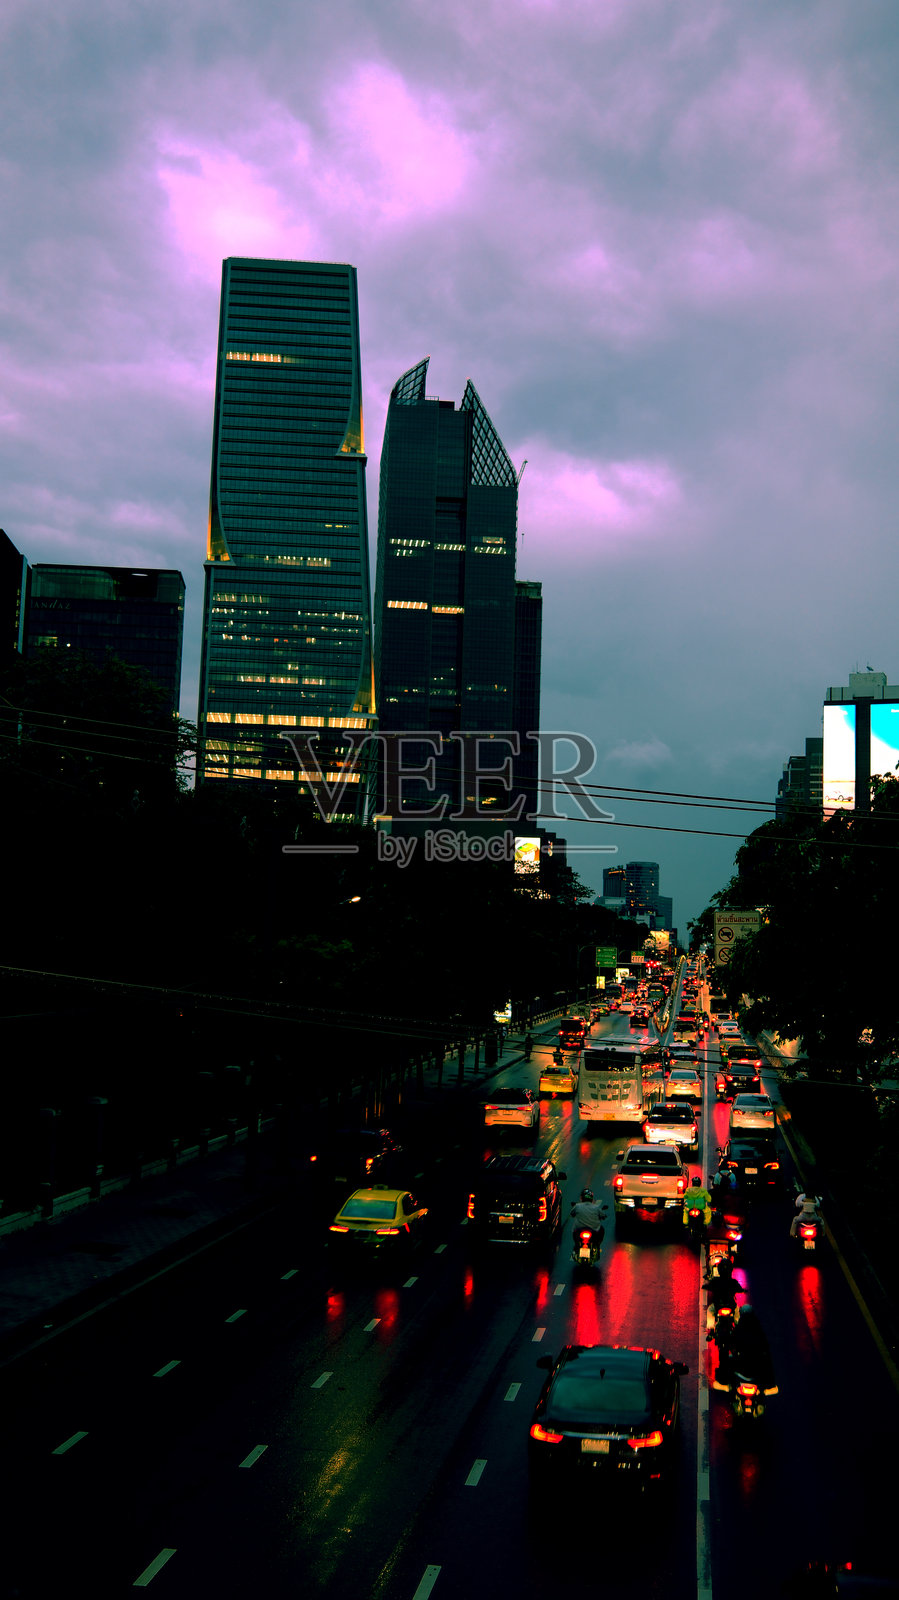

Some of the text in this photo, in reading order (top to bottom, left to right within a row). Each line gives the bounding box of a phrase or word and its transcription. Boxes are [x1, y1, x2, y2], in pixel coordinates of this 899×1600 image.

[717, 914, 758, 922] ห้ามขึ้นสะพาน
